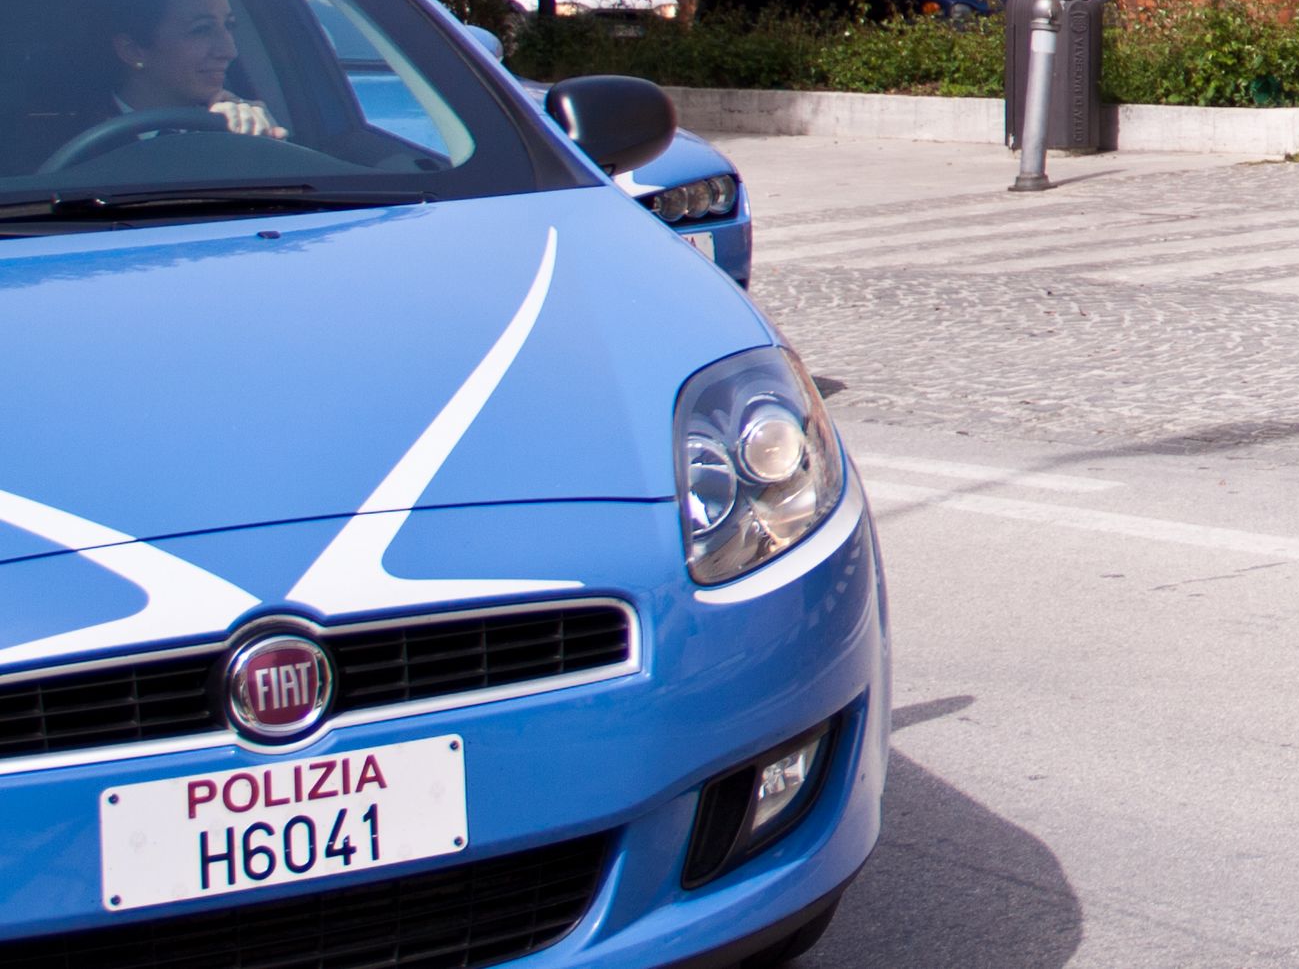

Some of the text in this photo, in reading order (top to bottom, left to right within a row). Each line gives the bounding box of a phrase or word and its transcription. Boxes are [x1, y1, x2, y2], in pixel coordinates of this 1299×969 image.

[254, 661, 312, 712] FIAT
[186, 753, 388, 820] POLIZIA
[199, 802, 381, 891] H6041
